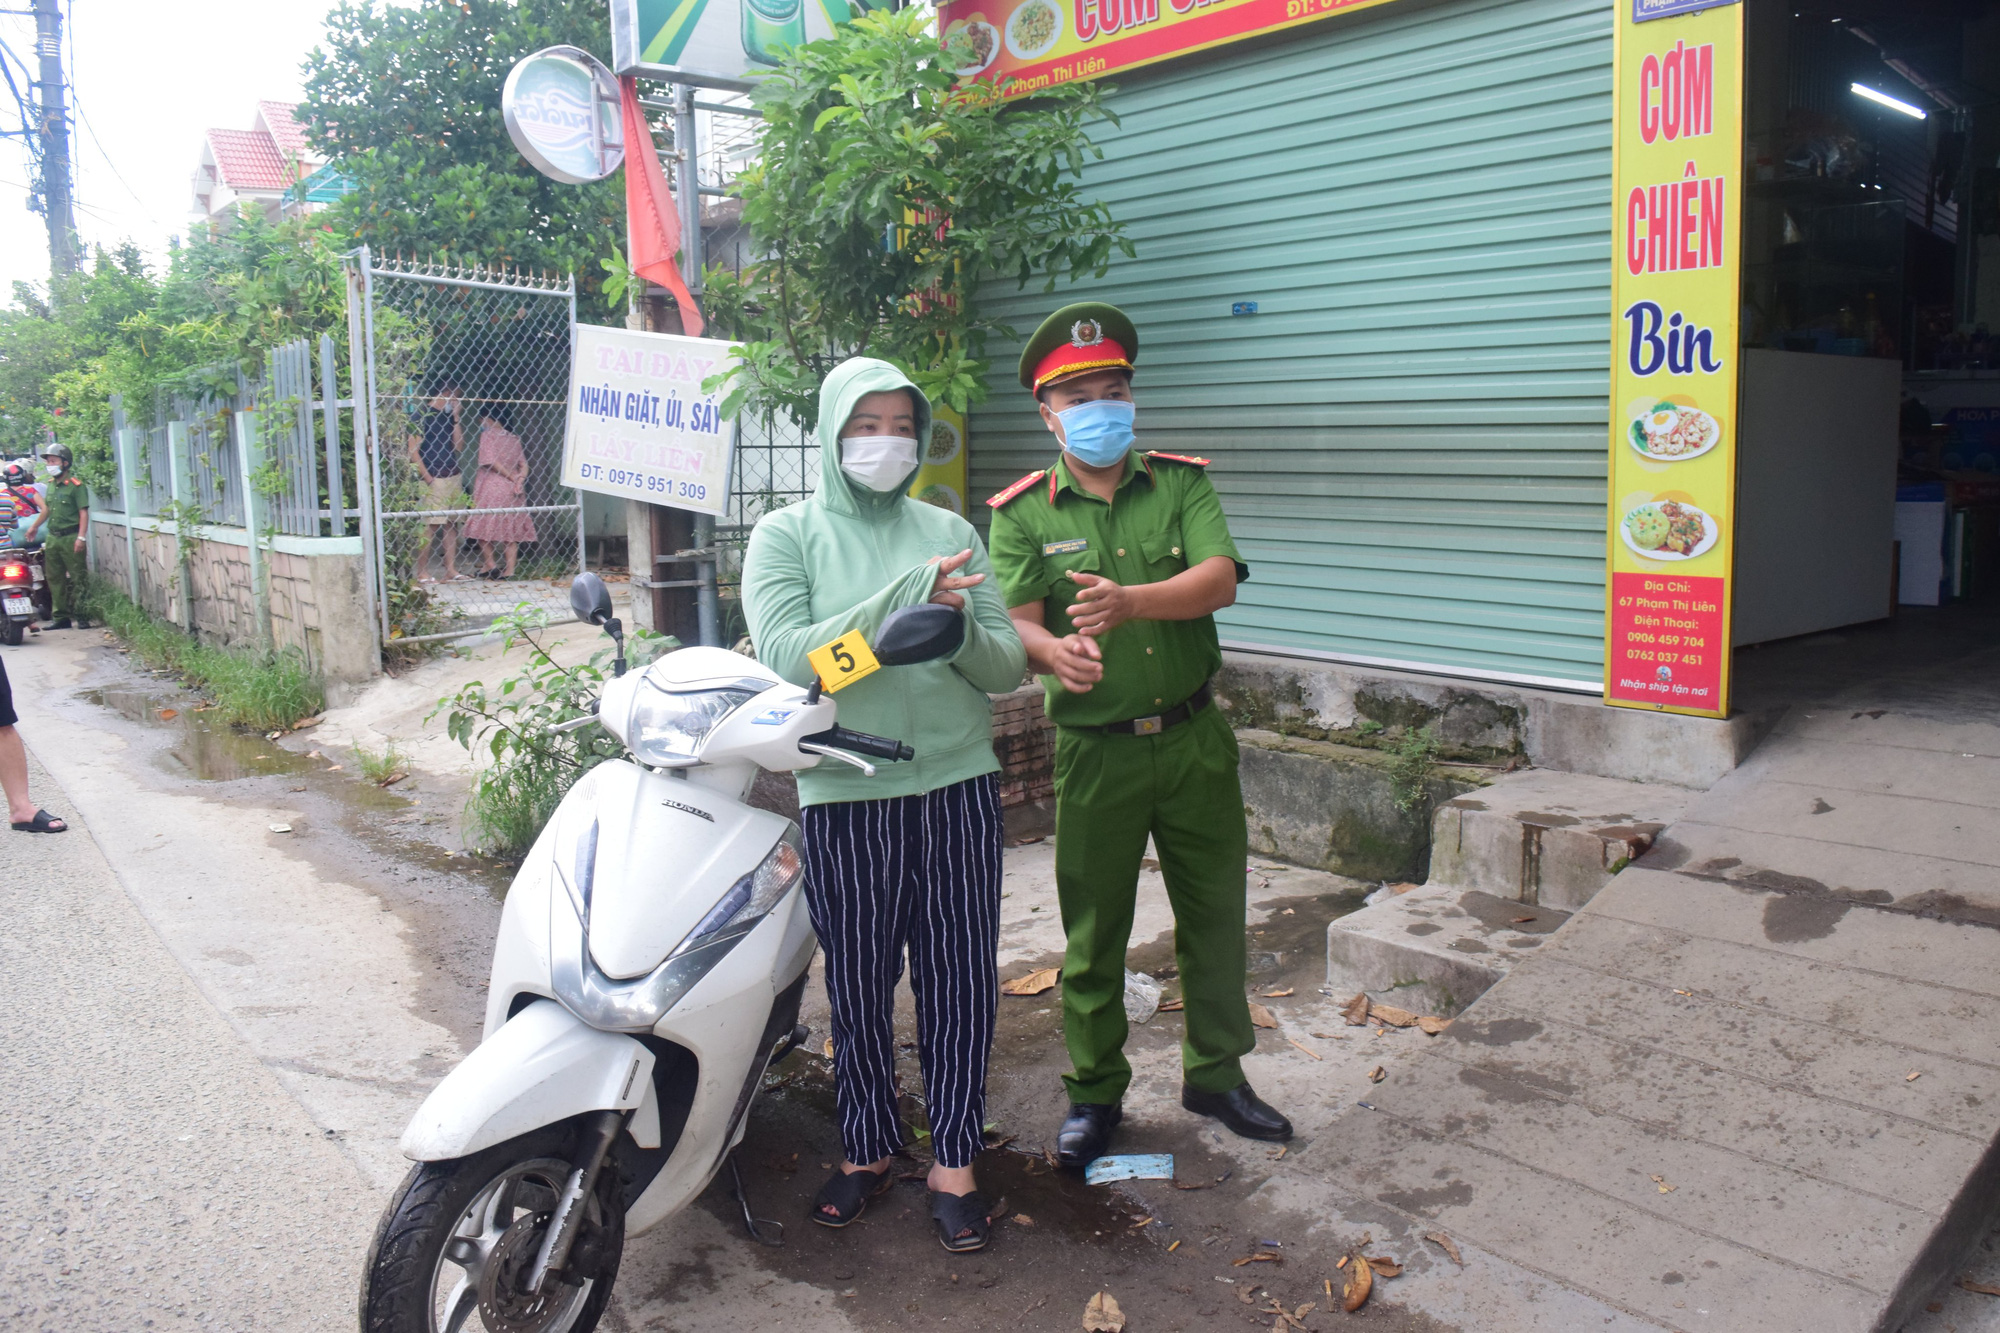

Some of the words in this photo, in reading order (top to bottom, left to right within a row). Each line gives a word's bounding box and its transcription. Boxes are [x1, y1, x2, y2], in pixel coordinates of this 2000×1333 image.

[1077, 57, 1106, 76] Liên
[1639, 39, 1714, 145] CƠM
[1626, 160, 1724, 276] CHIÊN
[1624, 300, 1722, 376] Bin
[597, 347, 644, 377] TẠI
[651, 352, 714, 383] ĐÂY
[579, 383, 621, 423] NHẬN
[625, 389, 660, 429] GIẶT,
[665, 390, 685, 432] ỦI,
[691, 395, 721, 435] SẤY
[589, 430, 638, 463] LẤY
[645, 436, 704, 474] LIỀN
[581, 464, 604, 481] ĐT:
[609, 469, 643, 488] 0975
[647, 476, 673, 494] 951
[679, 482, 706, 500] 309
[1644, 580, 1664, 593] Địa
[1667, 581, 1691, 593] Chỉ:
[1619, 597, 1633, 606] 67
[1636, 597, 1669, 611] Phạm
[1672, 600, 1689, 613] Thị
[1692, 600, 1716, 612] Liên
[1634, 615, 1660, 628] Điện
[1663, 617, 1699, 631] Thoại:
[1627, 632, 1655, 643] 0906
[1658, 635, 1680, 645] 459
[1683, 636, 1704, 648] 704
[830, 642, 855, 672] 5
[1627, 649, 1654, 661] 0762
[1657, 652, 1679, 663] 037
[1682, 654, 1702, 665] 451
[1620, 679, 1646, 691] Nhận
[1648, 681, 1669, 693] ship
[1672, 684, 1689, 695] tận
[1691, 687, 1708, 696] nơi
[662, 798, 714, 822] HONDA
